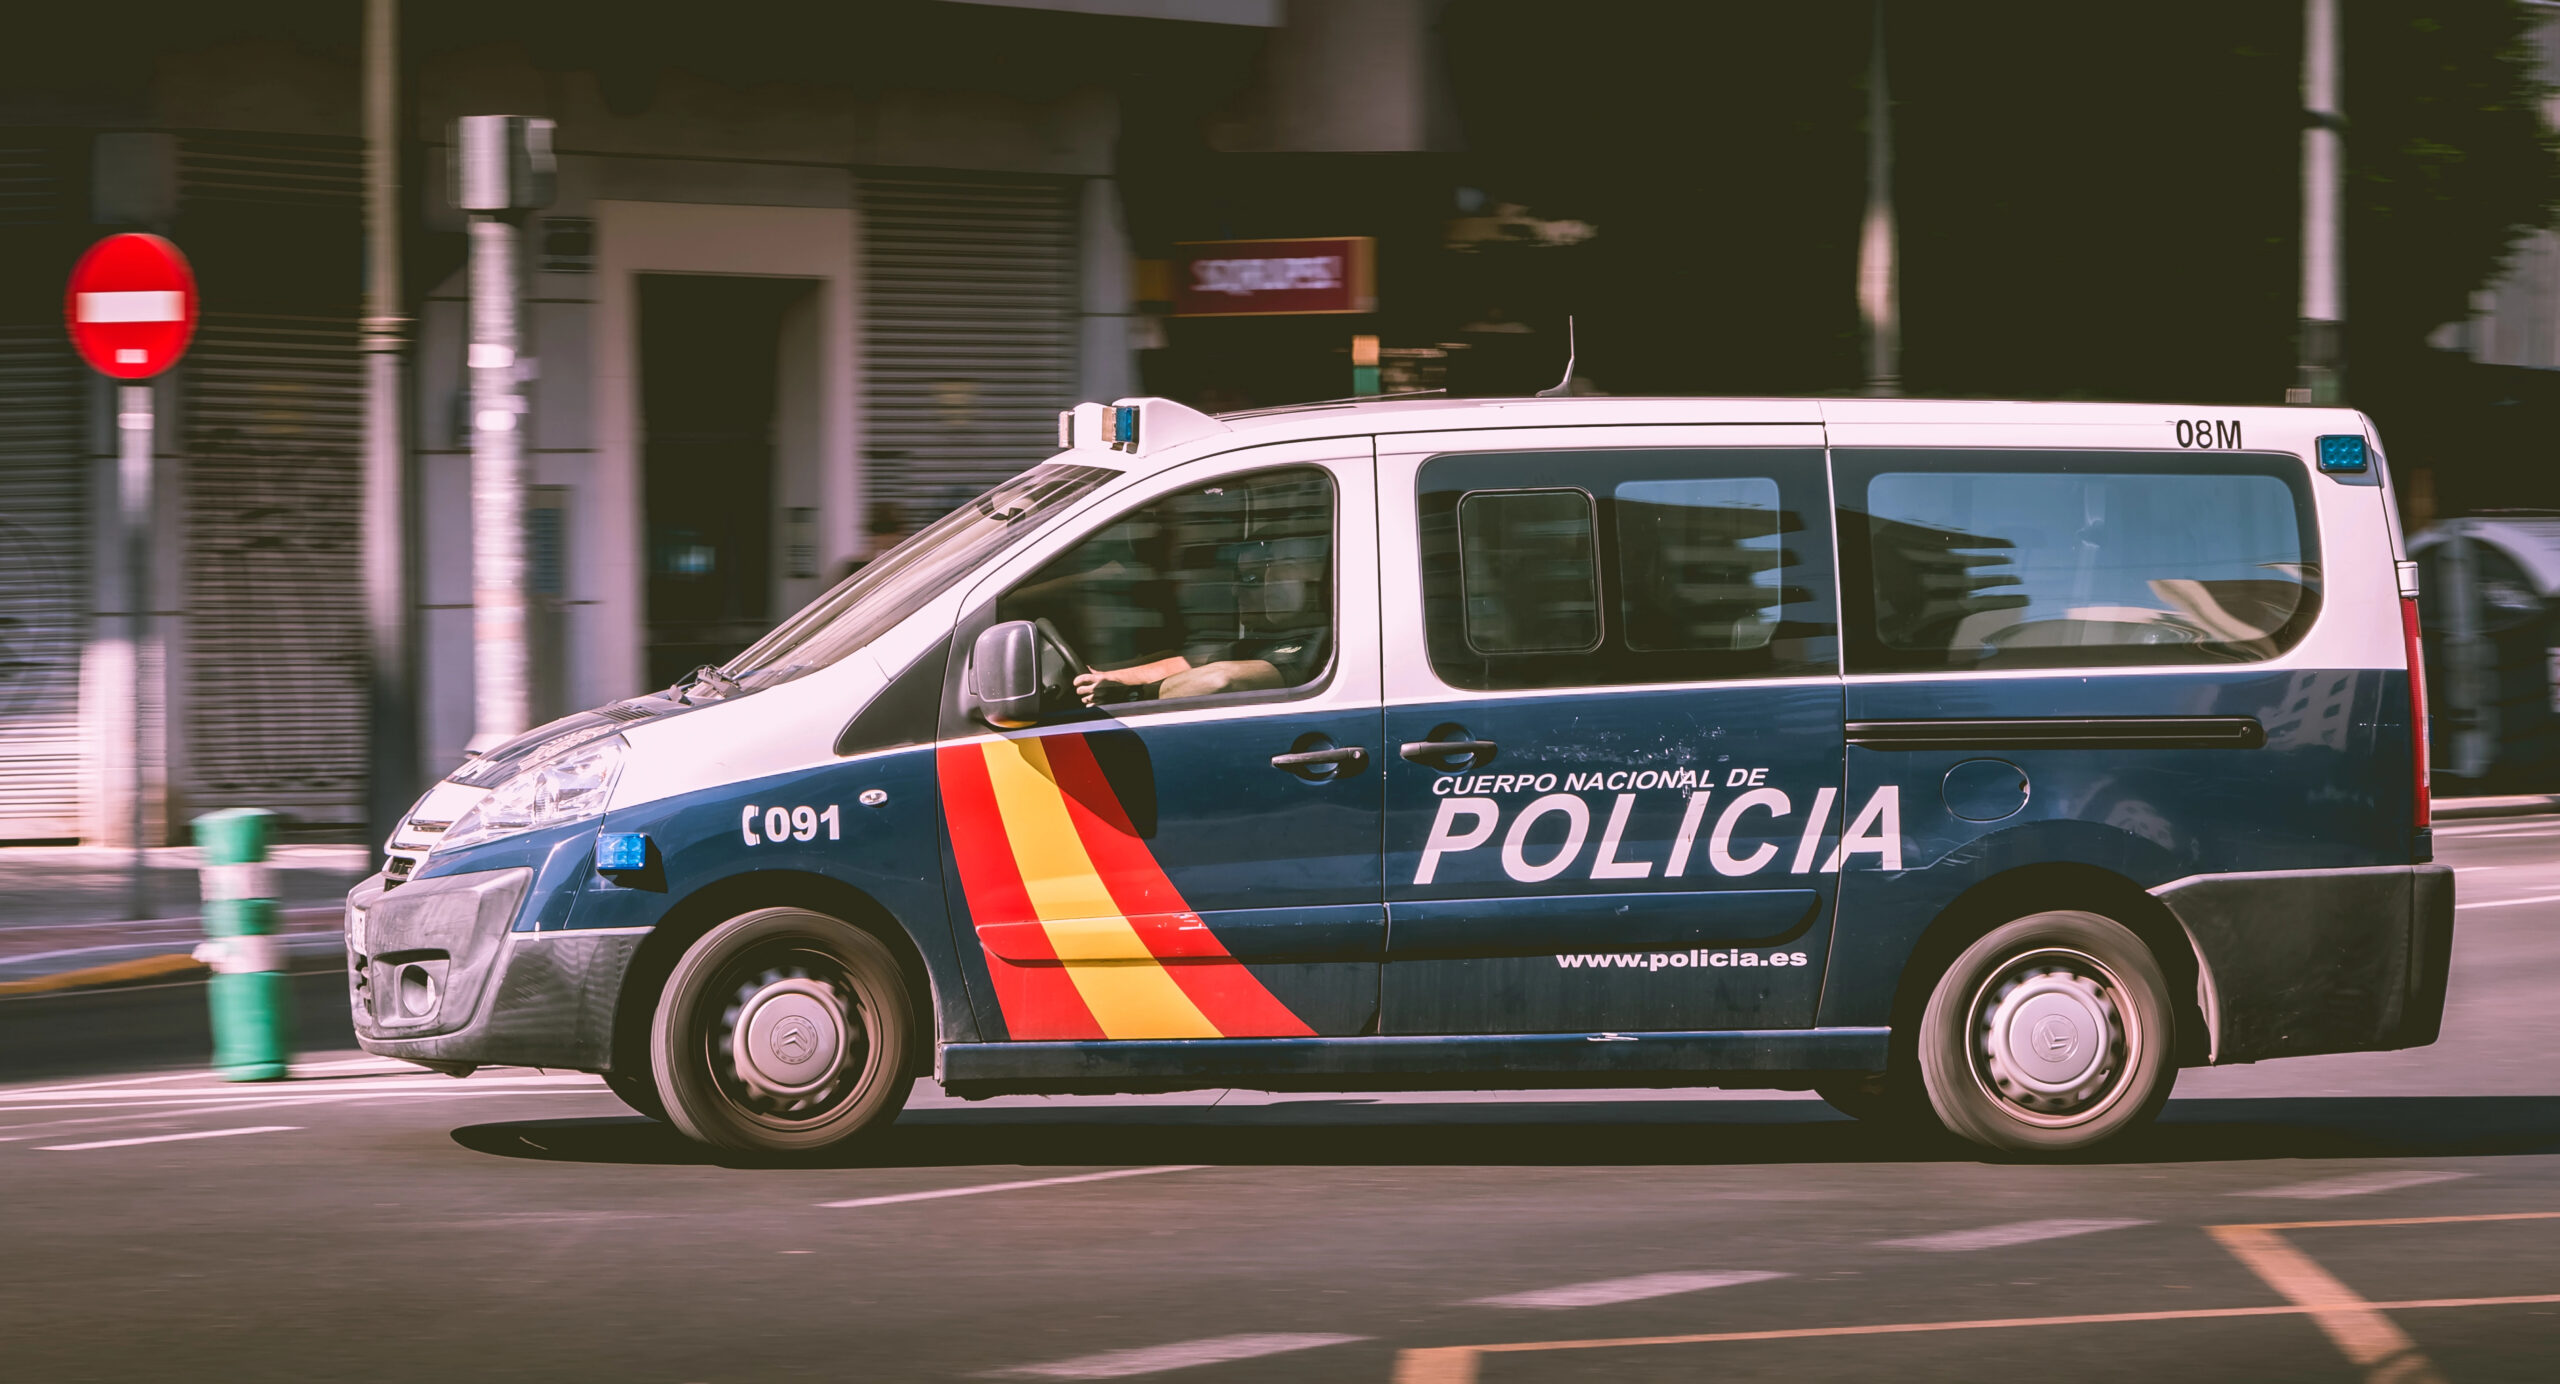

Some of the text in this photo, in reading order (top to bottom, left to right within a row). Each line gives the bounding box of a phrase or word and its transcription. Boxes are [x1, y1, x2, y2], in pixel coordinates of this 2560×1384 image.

[2176, 419, 2242, 449] 08M
[1433, 768, 1769, 795] CUERPO NACIONAL DE
[764, 804, 840, 843] 091
[1413, 785, 1903, 885] POLICIA
[1556, 949, 1808, 972] www.policia.es
